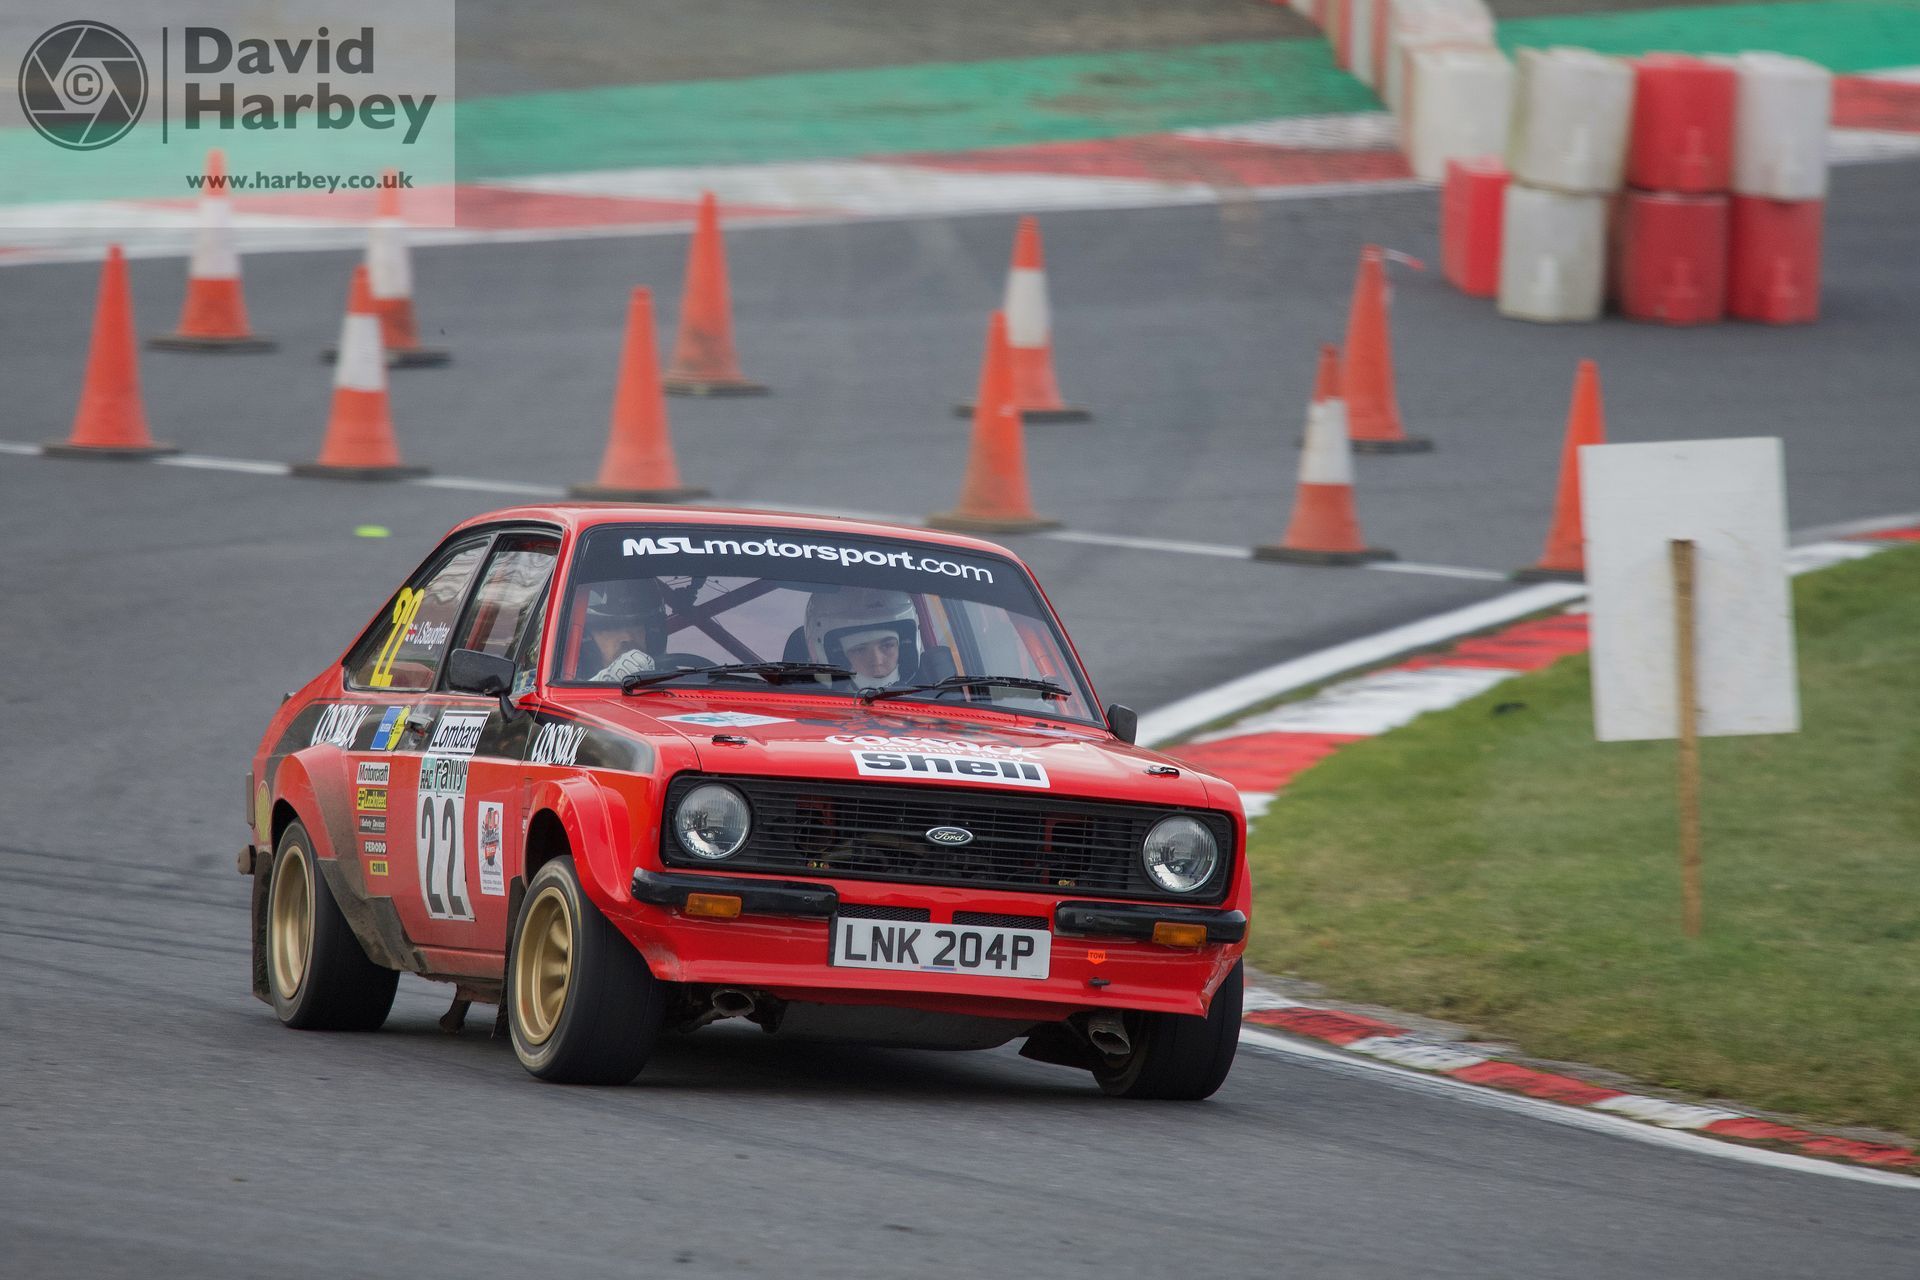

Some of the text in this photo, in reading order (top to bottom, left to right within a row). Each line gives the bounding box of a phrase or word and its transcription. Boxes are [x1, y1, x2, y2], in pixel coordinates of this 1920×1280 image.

[623, 537, 994, 584] MSLmotorsport.com
[369, 587, 425, 687] 22
[431, 718, 487, 749] Lombard
[359, 764, 389, 782] Motorcraft
[420, 769, 434, 790] RAC
[365, 842, 387, 854] FERODO
[934, 831, 965, 841] Ford
[421, 797, 466, 916] 22
[845, 925, 1034, 971] LNK 204P
[1088, 952, 1105, 960] TOW
